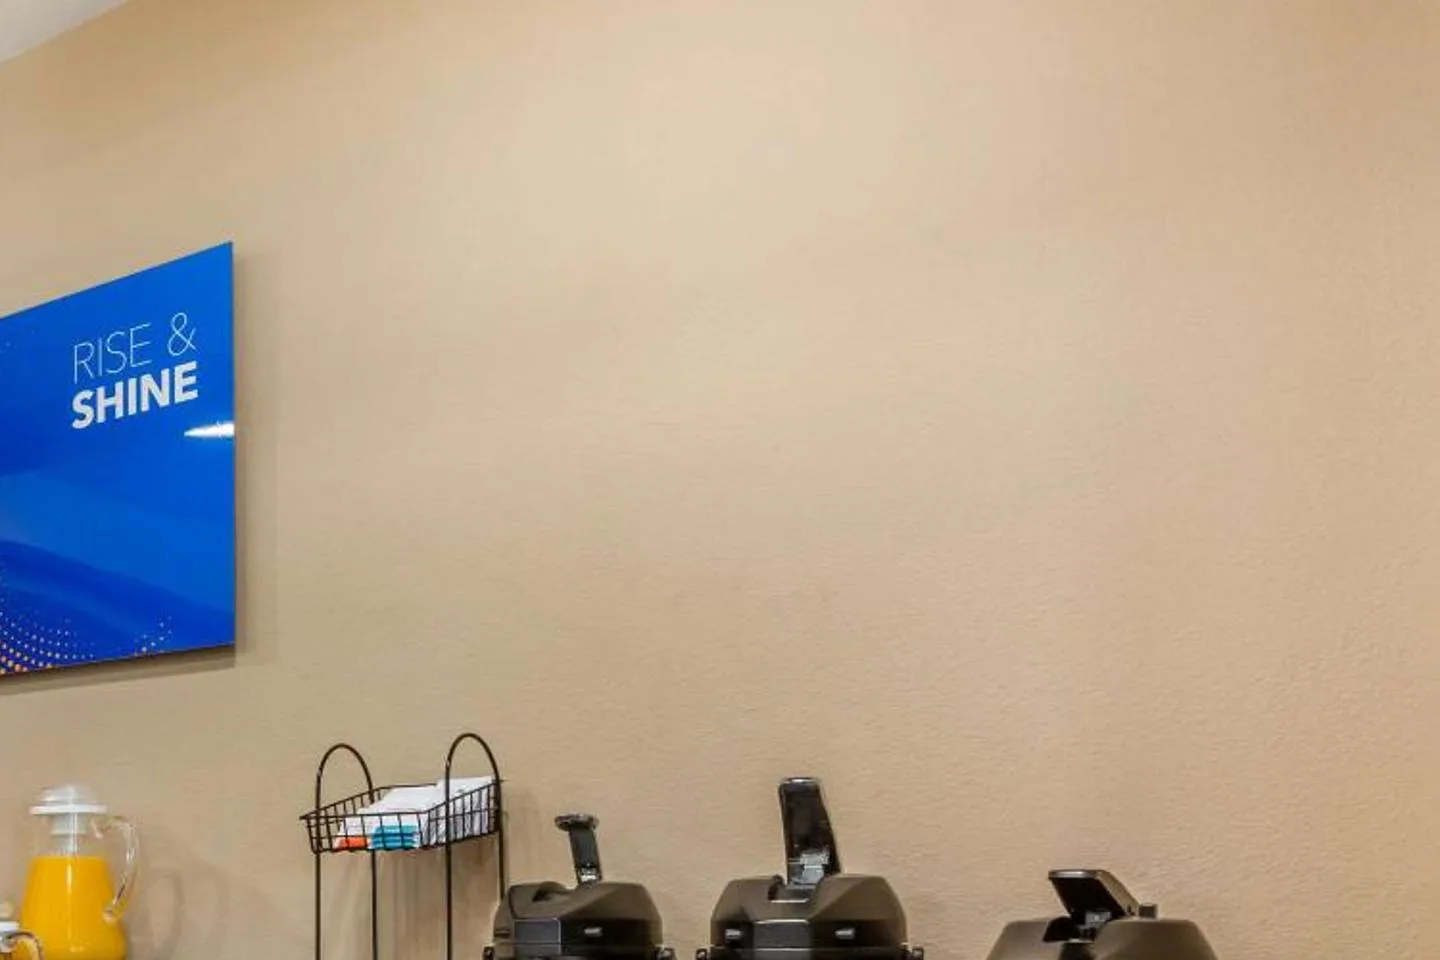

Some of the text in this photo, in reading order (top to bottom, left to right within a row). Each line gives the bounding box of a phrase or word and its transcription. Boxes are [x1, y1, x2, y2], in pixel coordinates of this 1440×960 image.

[73, 312, 198, 385] RISE &
[72, 360, 199, 429] SHINE
